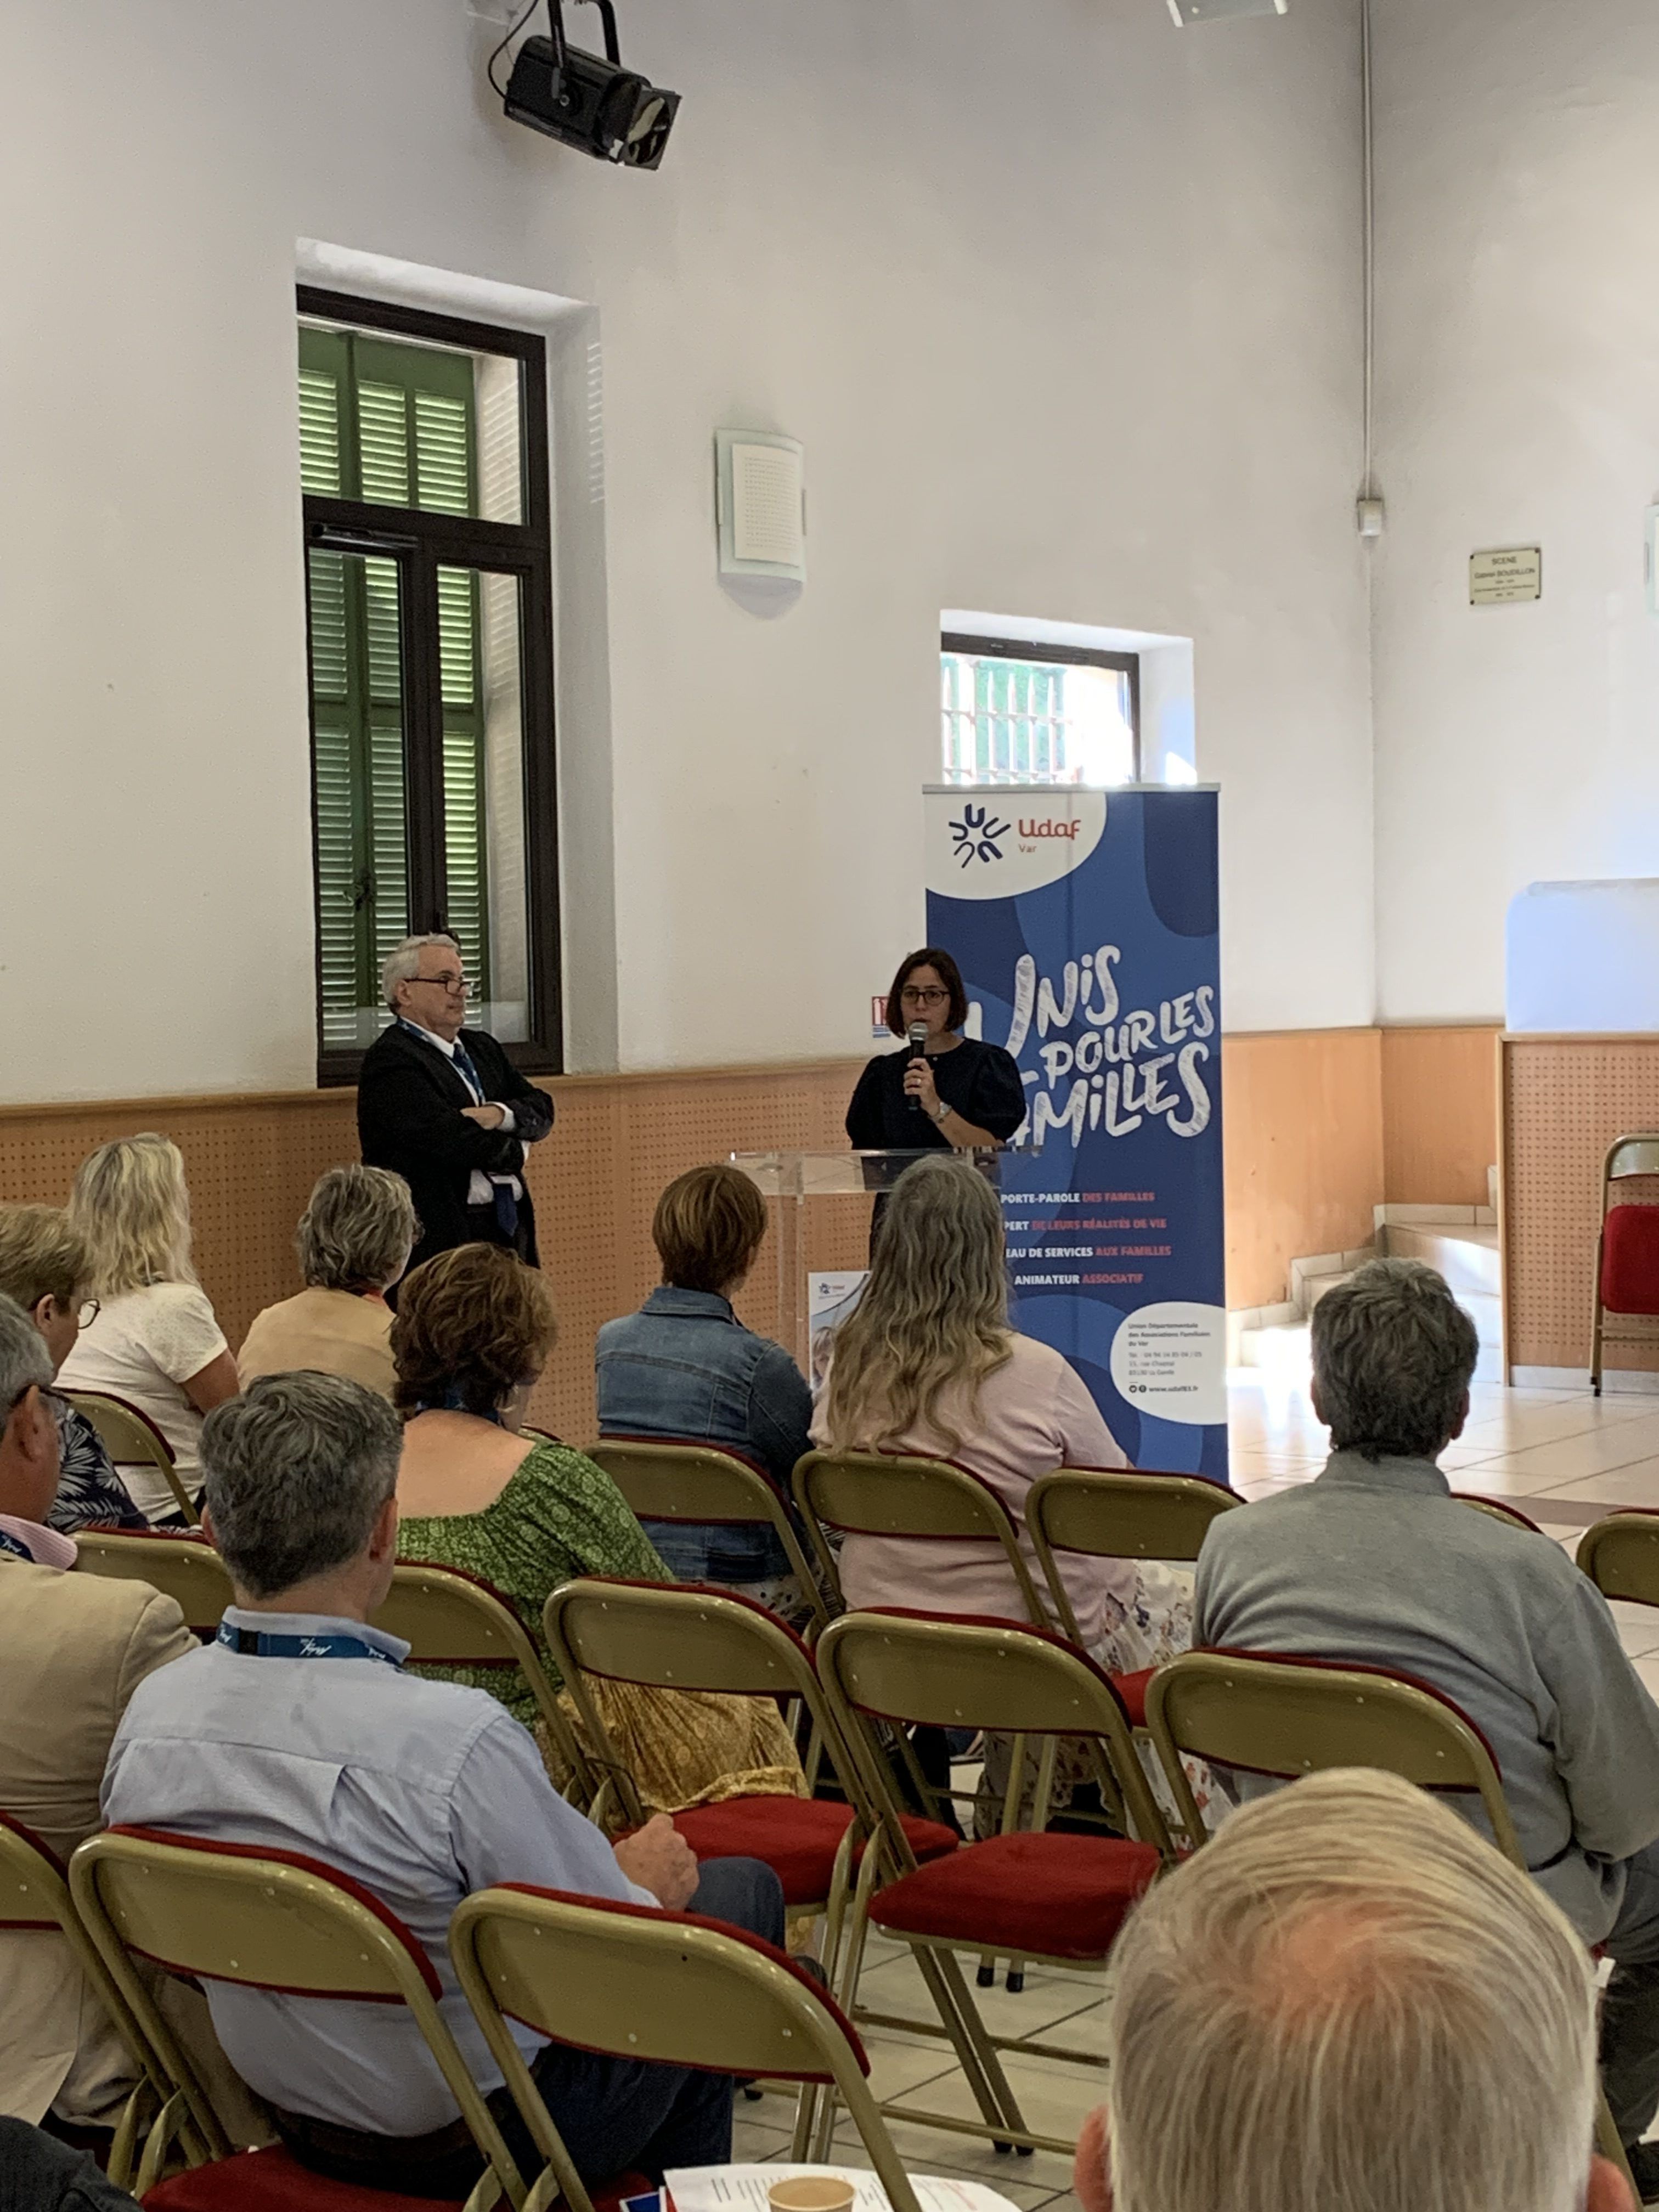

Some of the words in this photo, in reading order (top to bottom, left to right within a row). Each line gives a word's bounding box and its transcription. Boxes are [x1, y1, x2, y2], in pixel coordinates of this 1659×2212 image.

[1019, 819, 1081, 840] Udaf
[1018, 844, 1036, 853] Var
[1039, 1010, 1158, 1090] POUR
[1160, 985, 1214, 1044] LES
[1000, 1193, 1080, 1203] PORTE-PAROLE
[1082, 1192, 1102, 1203] DES
[1104, 1192, 1155, 1202] FAMILLES
[1004, 1221, 1029, 1231] PERT
[1150, 1218, 1167, 1228] VIE
[1006, 1248, 1026, 1258] EAU
[1028, 1248, 1043, 1258] DE
[1045, 1247, 1093, 1257] SERVICES
[1095, 1246, 1118, 1256] AUX
[1121, 1246, 1171, 1256] FAMILLES
[1014, 1274, 1080, 1285] ANIMATEUR
[1082, 1273, 1144, 1284] ASSOCIATIF
